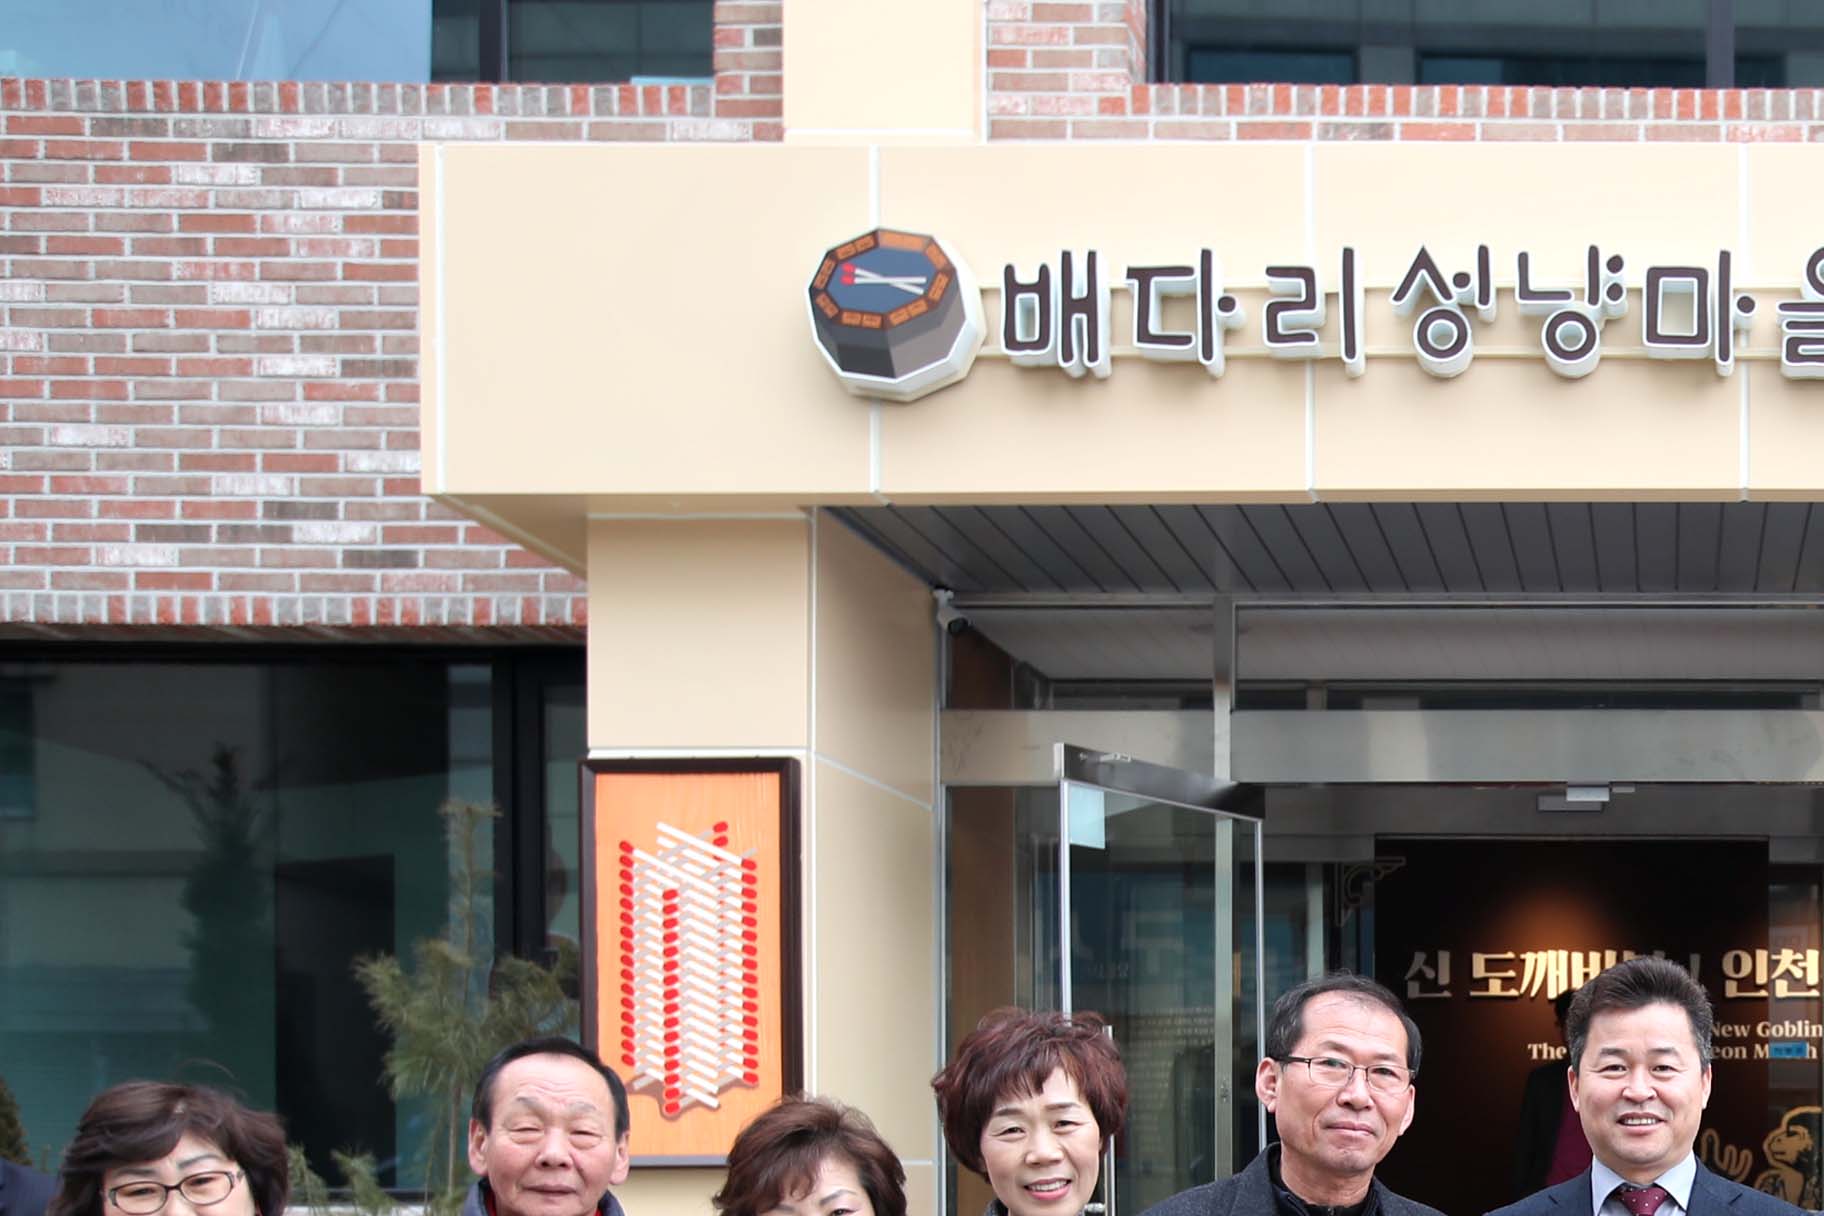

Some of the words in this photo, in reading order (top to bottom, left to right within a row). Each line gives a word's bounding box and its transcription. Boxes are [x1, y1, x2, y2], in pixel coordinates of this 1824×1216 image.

[1404, 949, 1453, 998] 신
[1756, 1020, 1823, 1039] Goblin
[1528, 1043, 1567, 1061] The
